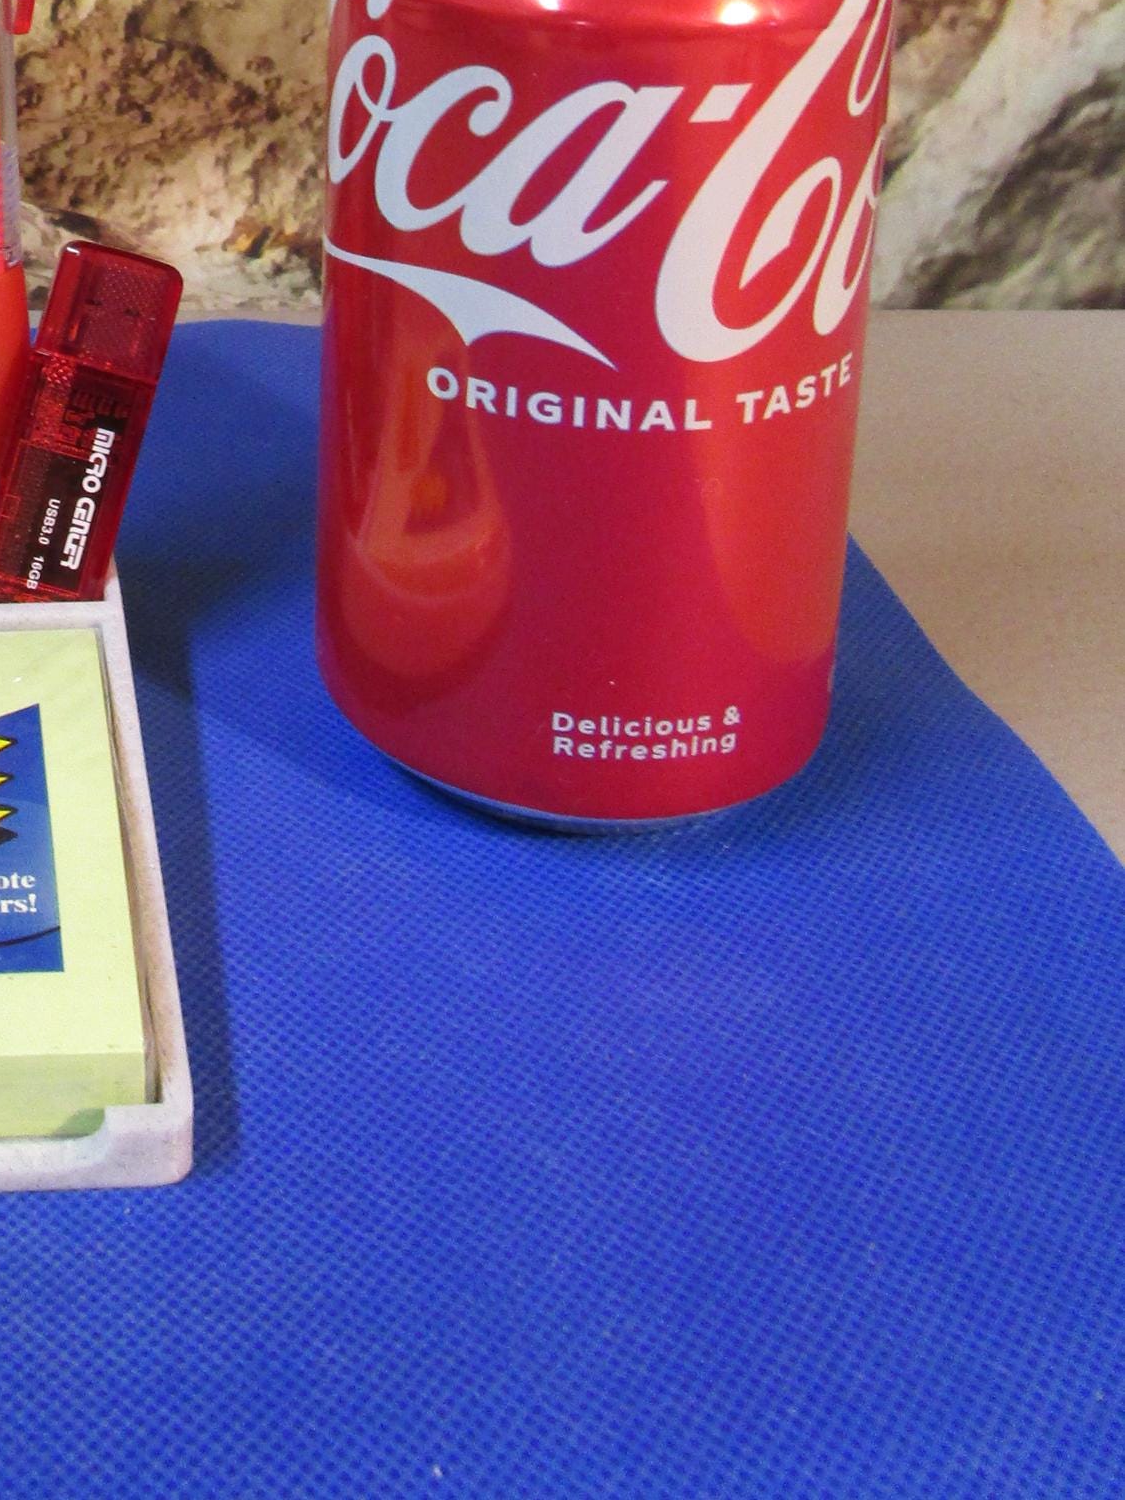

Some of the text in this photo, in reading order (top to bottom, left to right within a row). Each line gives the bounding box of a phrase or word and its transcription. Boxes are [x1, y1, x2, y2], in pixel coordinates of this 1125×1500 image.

[427, 352, 854, 431] ORIGINAL TASTE
[60, 427, 116, 572] MICRO CENTER
[25, 498, 61, 591] USB3.0 16GB
[551, 705, 742, 738] Delicious &
[552, 732, 737, 761] Refreshing
